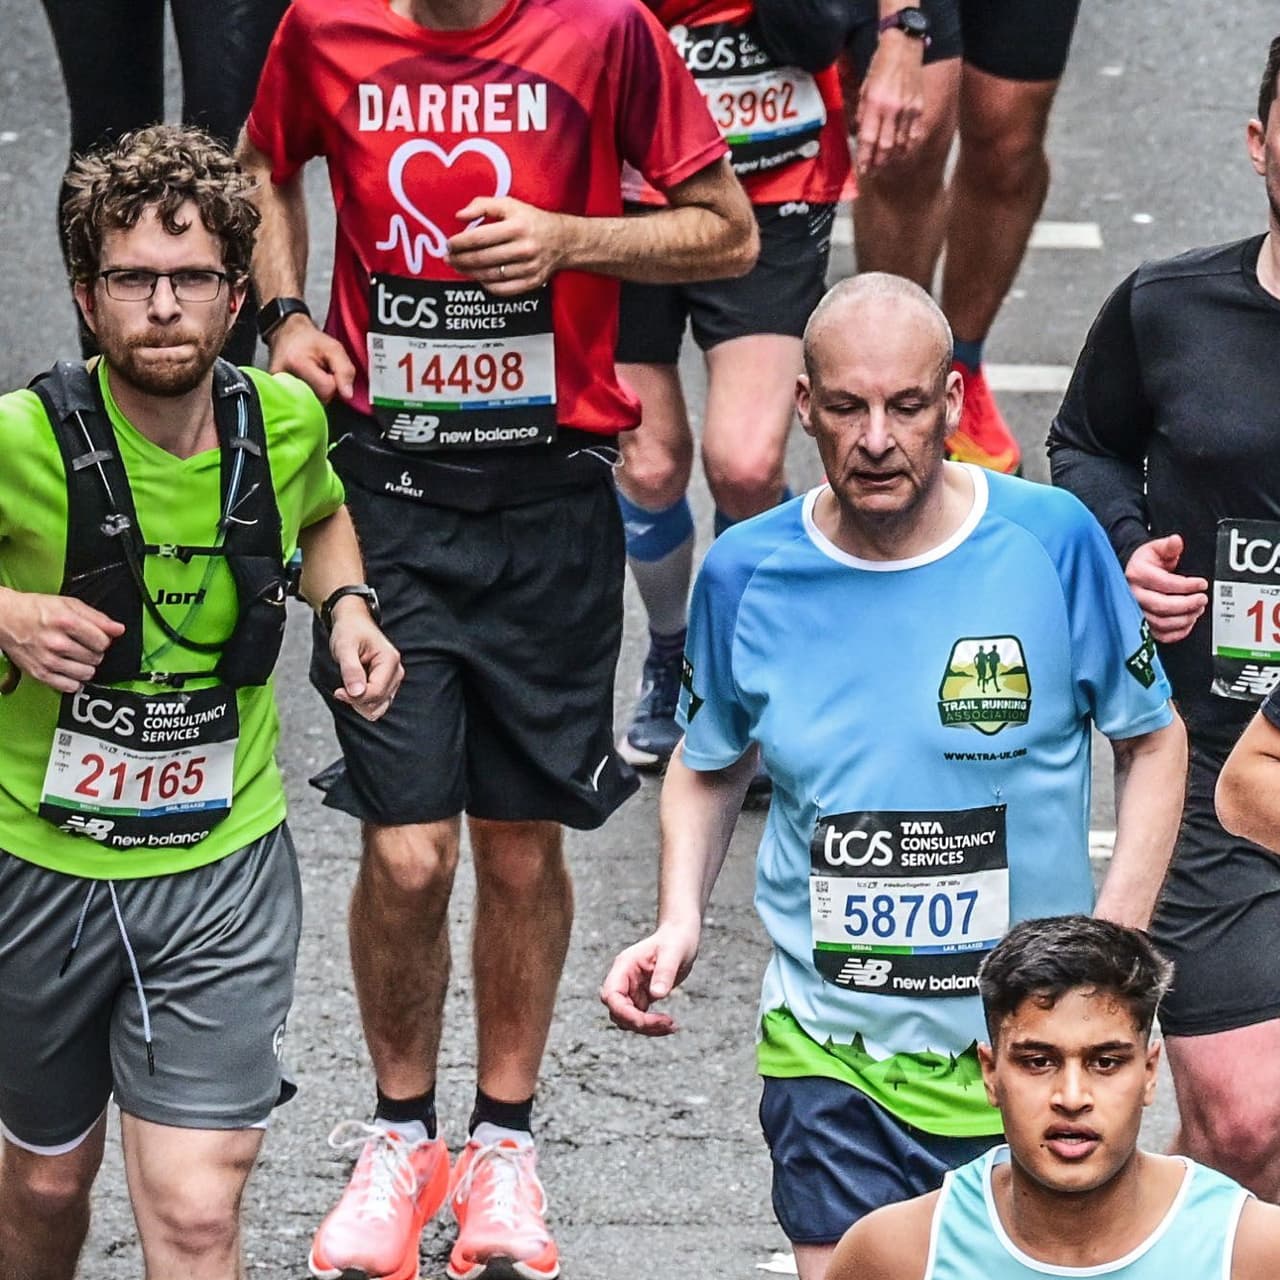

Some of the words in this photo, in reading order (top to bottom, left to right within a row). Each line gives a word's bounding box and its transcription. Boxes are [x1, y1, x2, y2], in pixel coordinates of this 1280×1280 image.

[358, 83, 547, 132] DARREN
[705, 82, 798, 128] 3962
[444, 290, 486, 302] TATA
[377, 283, 440, 329] tcs
[444, 299, 539, 318] CONSULTANCY
[445, 316, 507, 330] SERVICES
[397, 351, 525, 395] 14498
[439, 429, 472, 443] new
[474, 425, 539, 442] balance
[72, 684, 136, 736] tcs
[145, 702, 187, 715] TATA
[942, 700, 978, 711] TRAIL
[981, 699, 1028, 711] RUNNING
[143, 703, 227, 729] CONSULTANCY
[945, 709, 1027, 722] ASSOCIATION
[141, 726, 200, 743] SERVICES
[944, 748, 1028, 761] WWW.TRA-UK.ORG
[74, 752, 207, 802] 21165
[112, 832, 146, 846] new
[147, 828, 209, 846] balance
[900, 821, 944, 835] TATA
[824, 825, 893, 866] tcs
[900, 830, 996, 851] CONSULTANCY
[900, 851, 964, 867] SERVICES
[843, 889, 979, 938] 58707
[893, 976, 926, 990] new
[929, 974, 981, 990] balan
